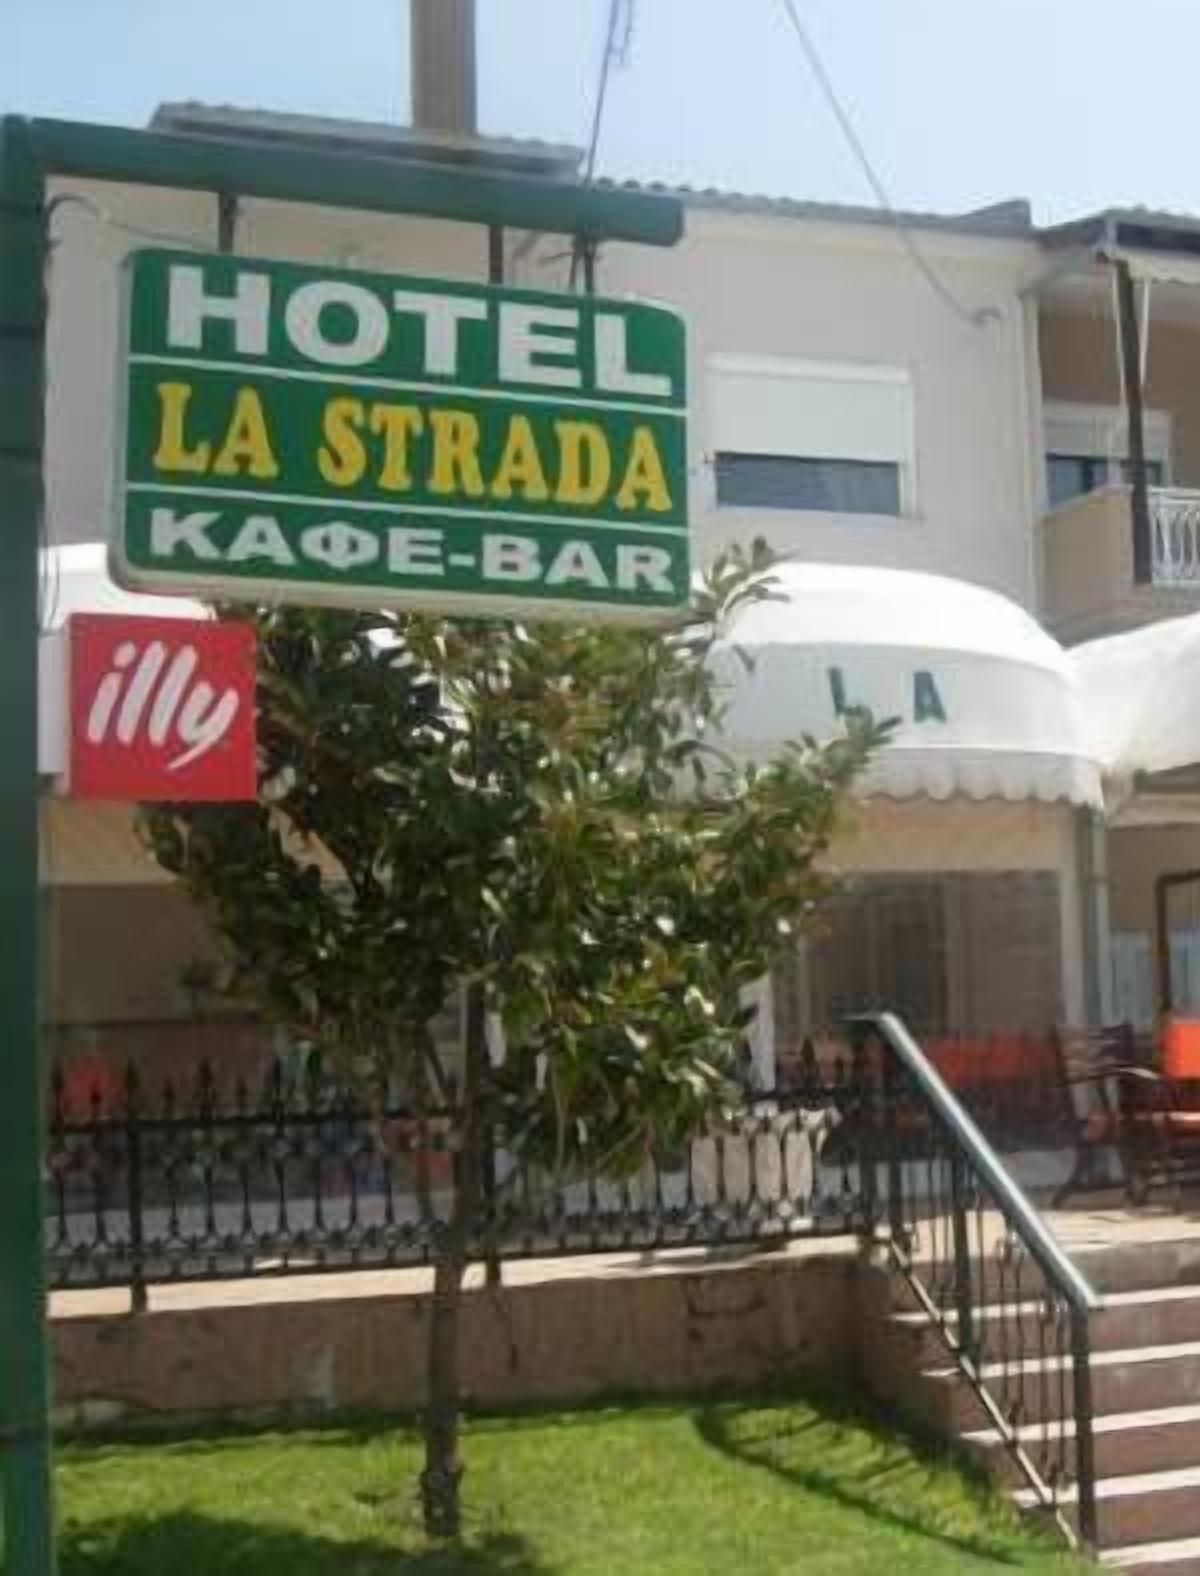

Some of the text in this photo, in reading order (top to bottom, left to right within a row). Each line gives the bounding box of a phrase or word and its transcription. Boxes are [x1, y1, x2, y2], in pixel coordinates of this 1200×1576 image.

[166, 265, 673, 397] HOTEL
[153, 382, 672, 511] LA STRADA
[87, 640, 239, 771] illy
